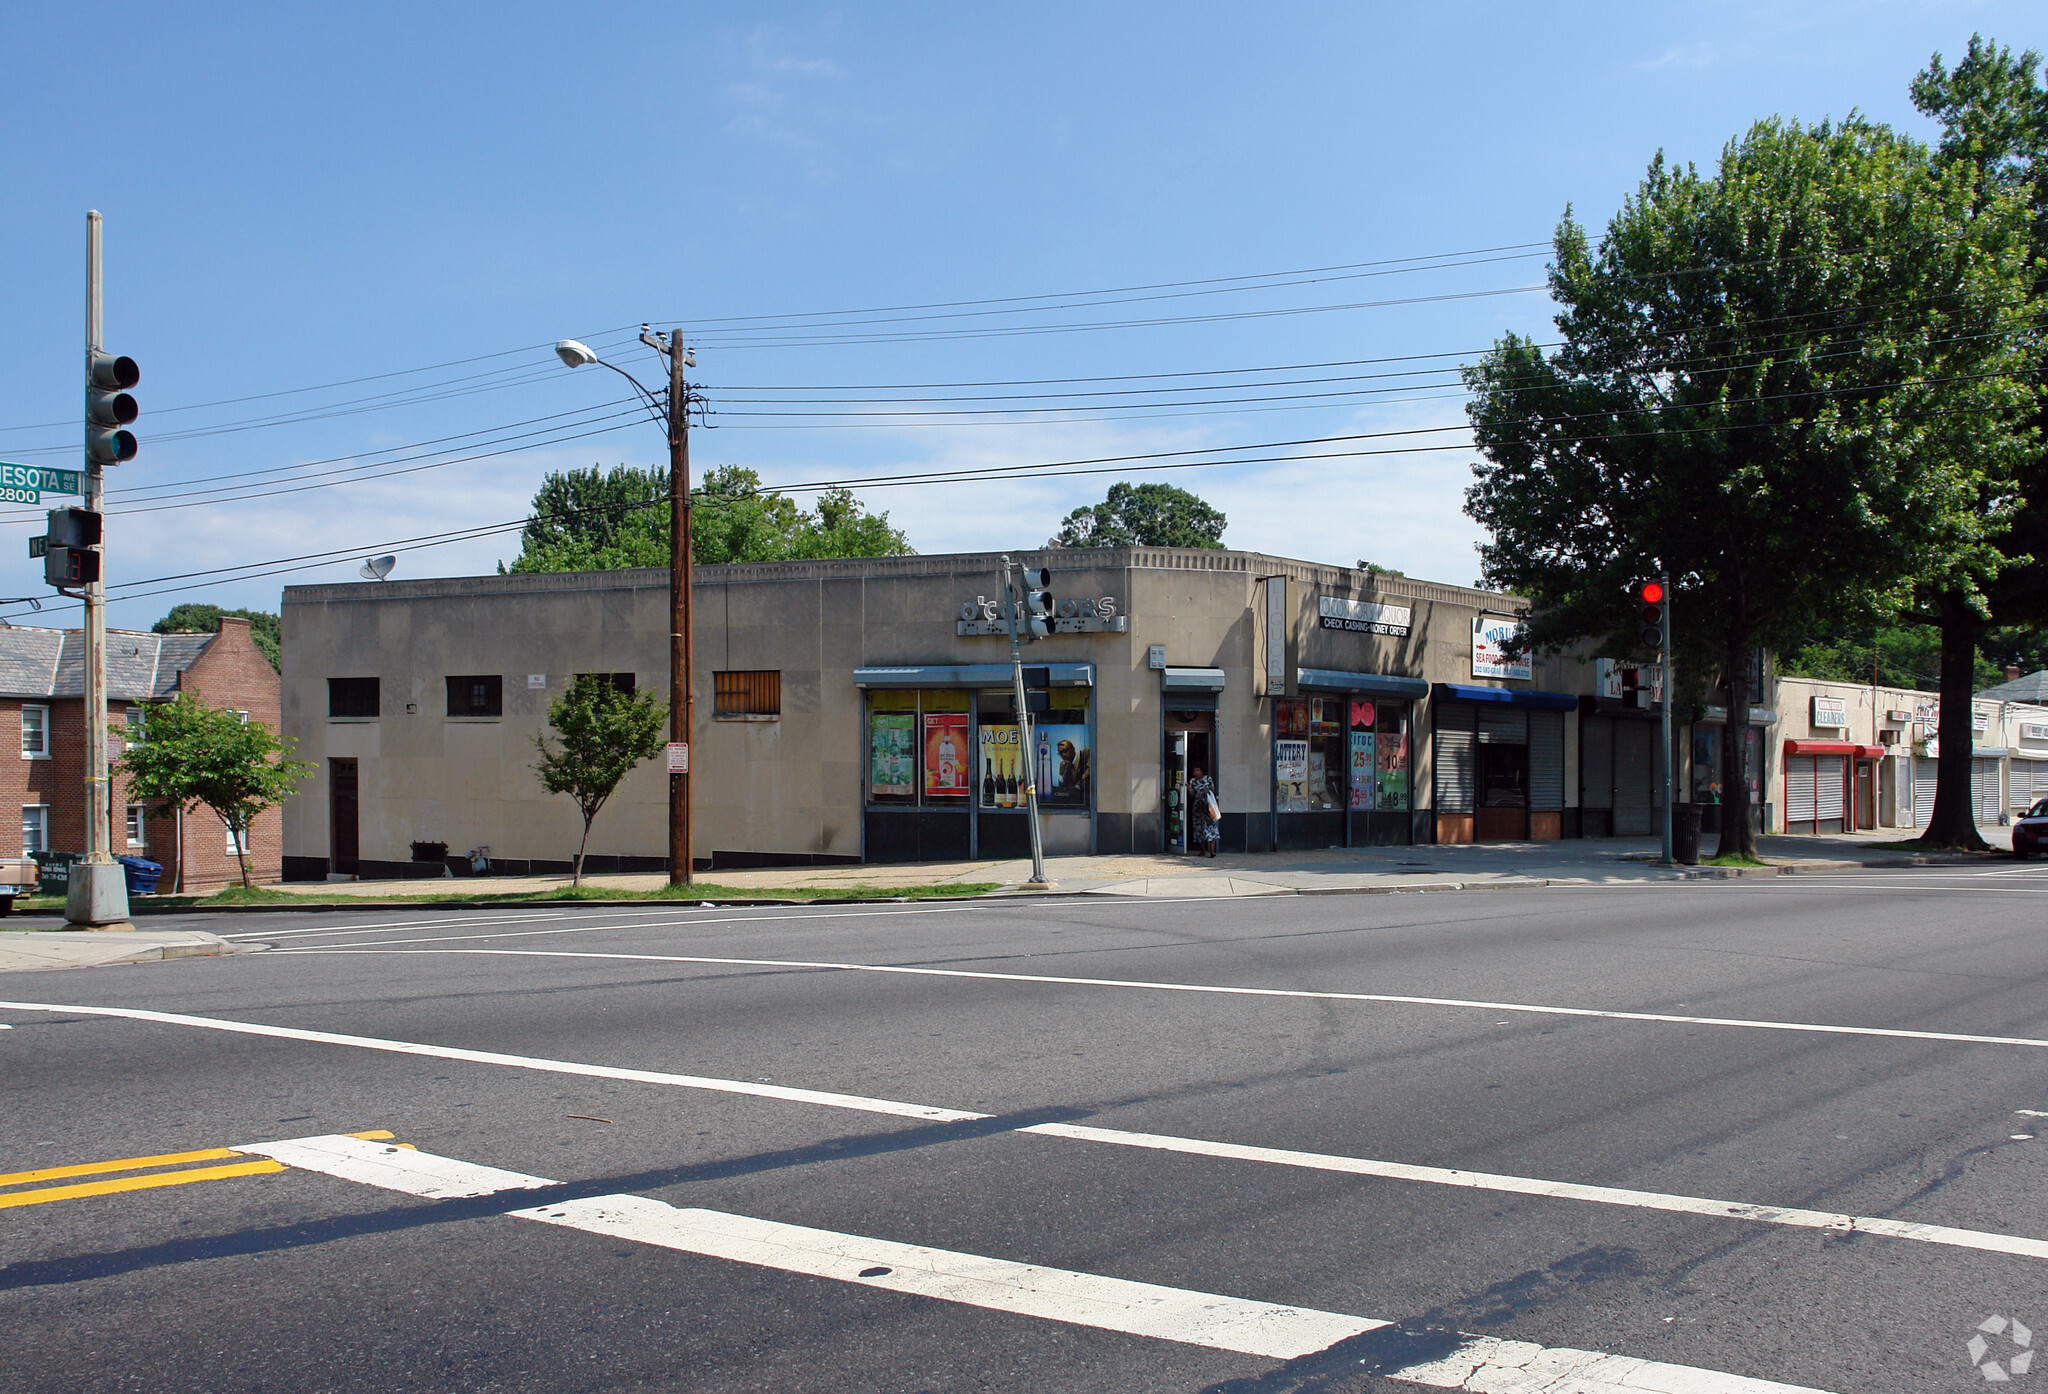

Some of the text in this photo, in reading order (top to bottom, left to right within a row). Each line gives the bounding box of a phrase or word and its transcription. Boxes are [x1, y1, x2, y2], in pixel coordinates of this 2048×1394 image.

[63, 473, 76, 482] AVE
[63, 482, 76, 491] SE
[1324, 618, 1343, 629] CHECK
[1389, 625, 1407, 637] ORDER
[1817, 710, 1845, 726] CLEANERS
[1275, 743, 1307, 761] LOTTERY
